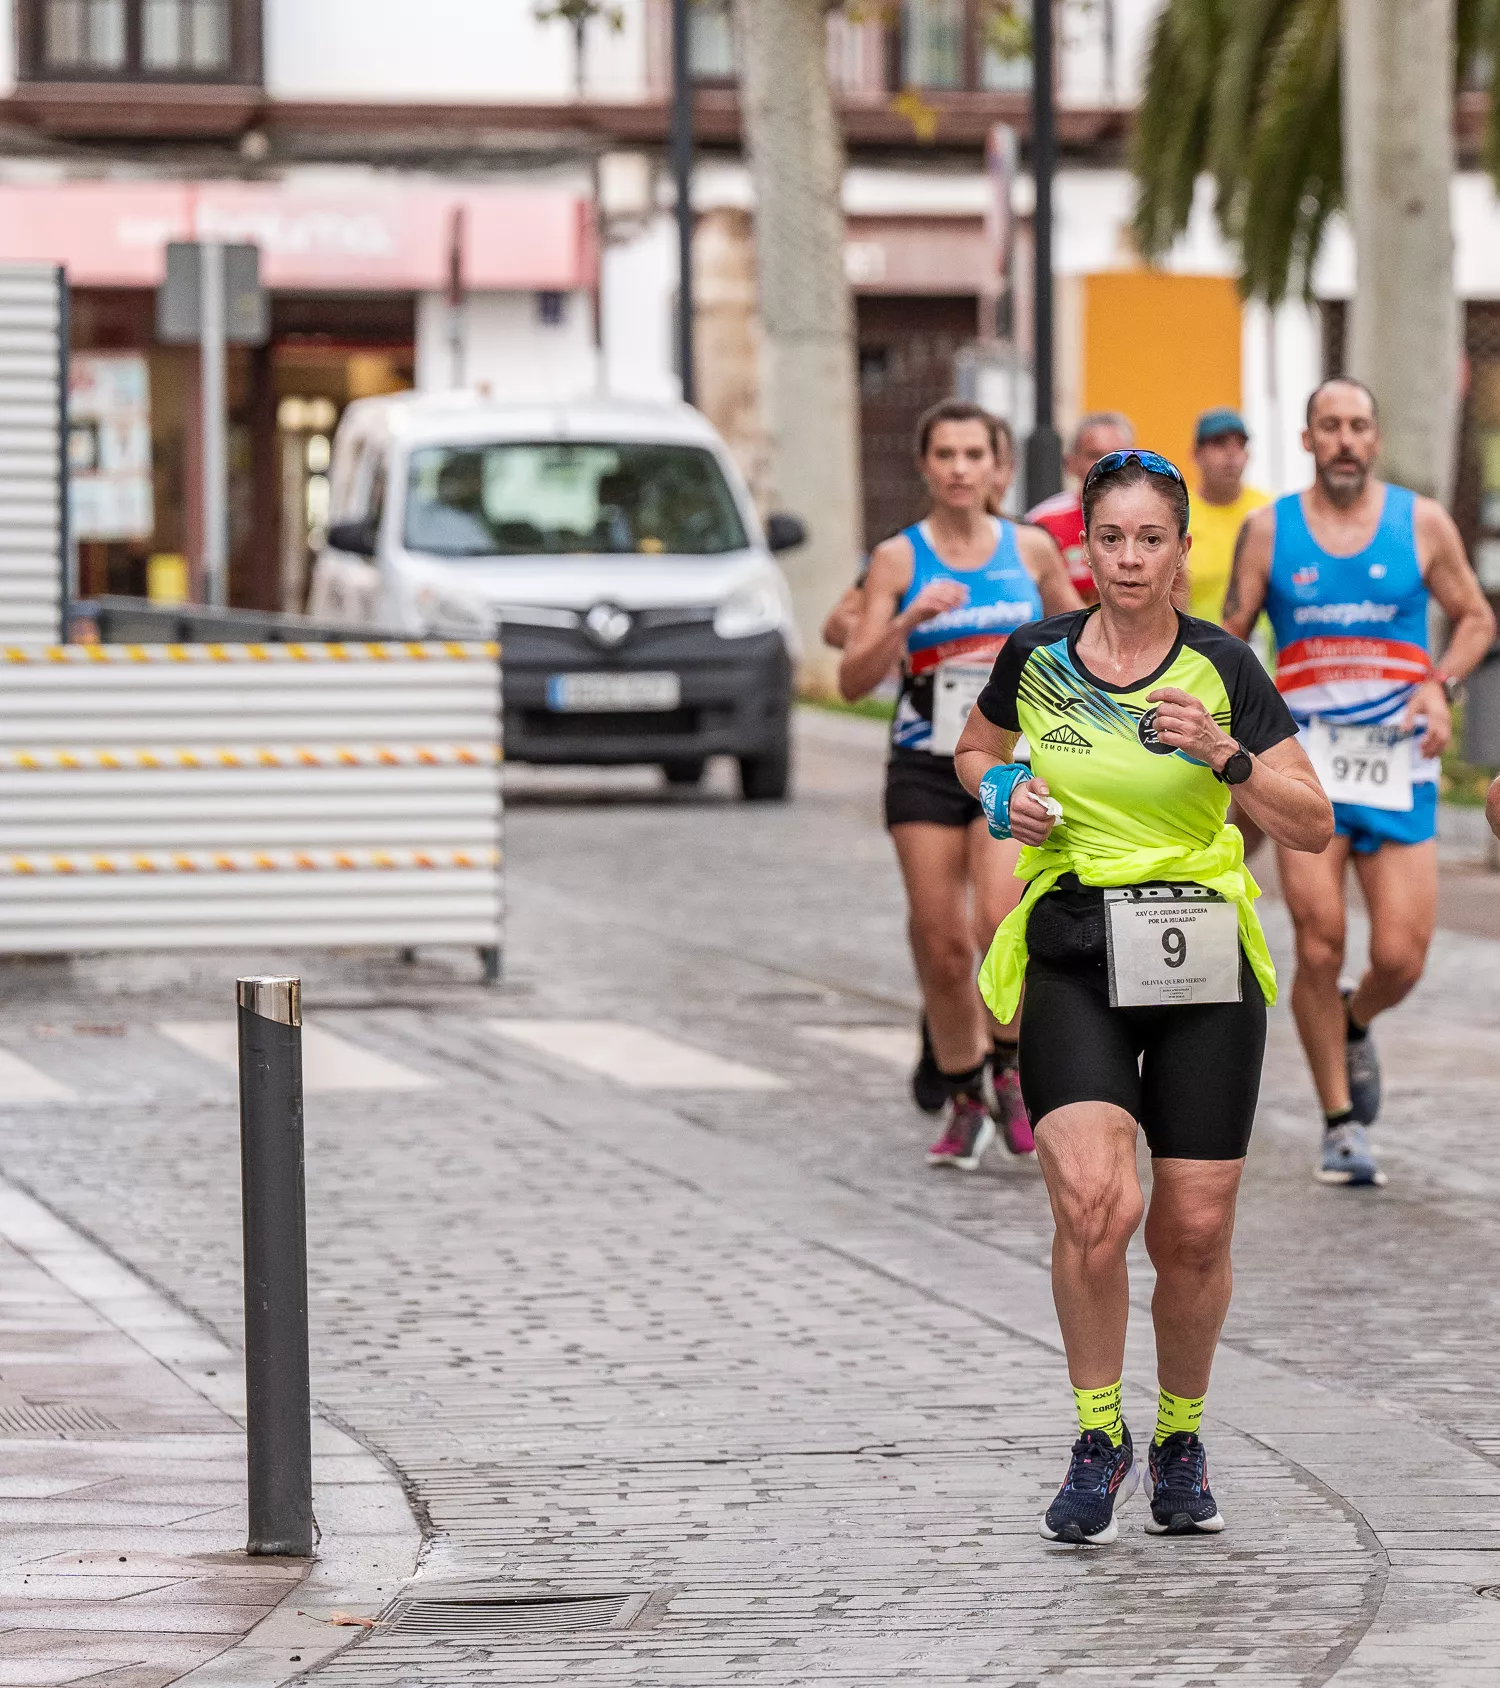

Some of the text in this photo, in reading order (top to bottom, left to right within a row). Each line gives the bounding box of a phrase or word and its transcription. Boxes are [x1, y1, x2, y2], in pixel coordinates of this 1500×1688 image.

[1041, 742, 1091, 755] ESMONSUR
[1332, 756, 1388, 785] 970
[1161, 927, 1186, 968] 9
[1092, 1390, 1112, 1400] XXV
